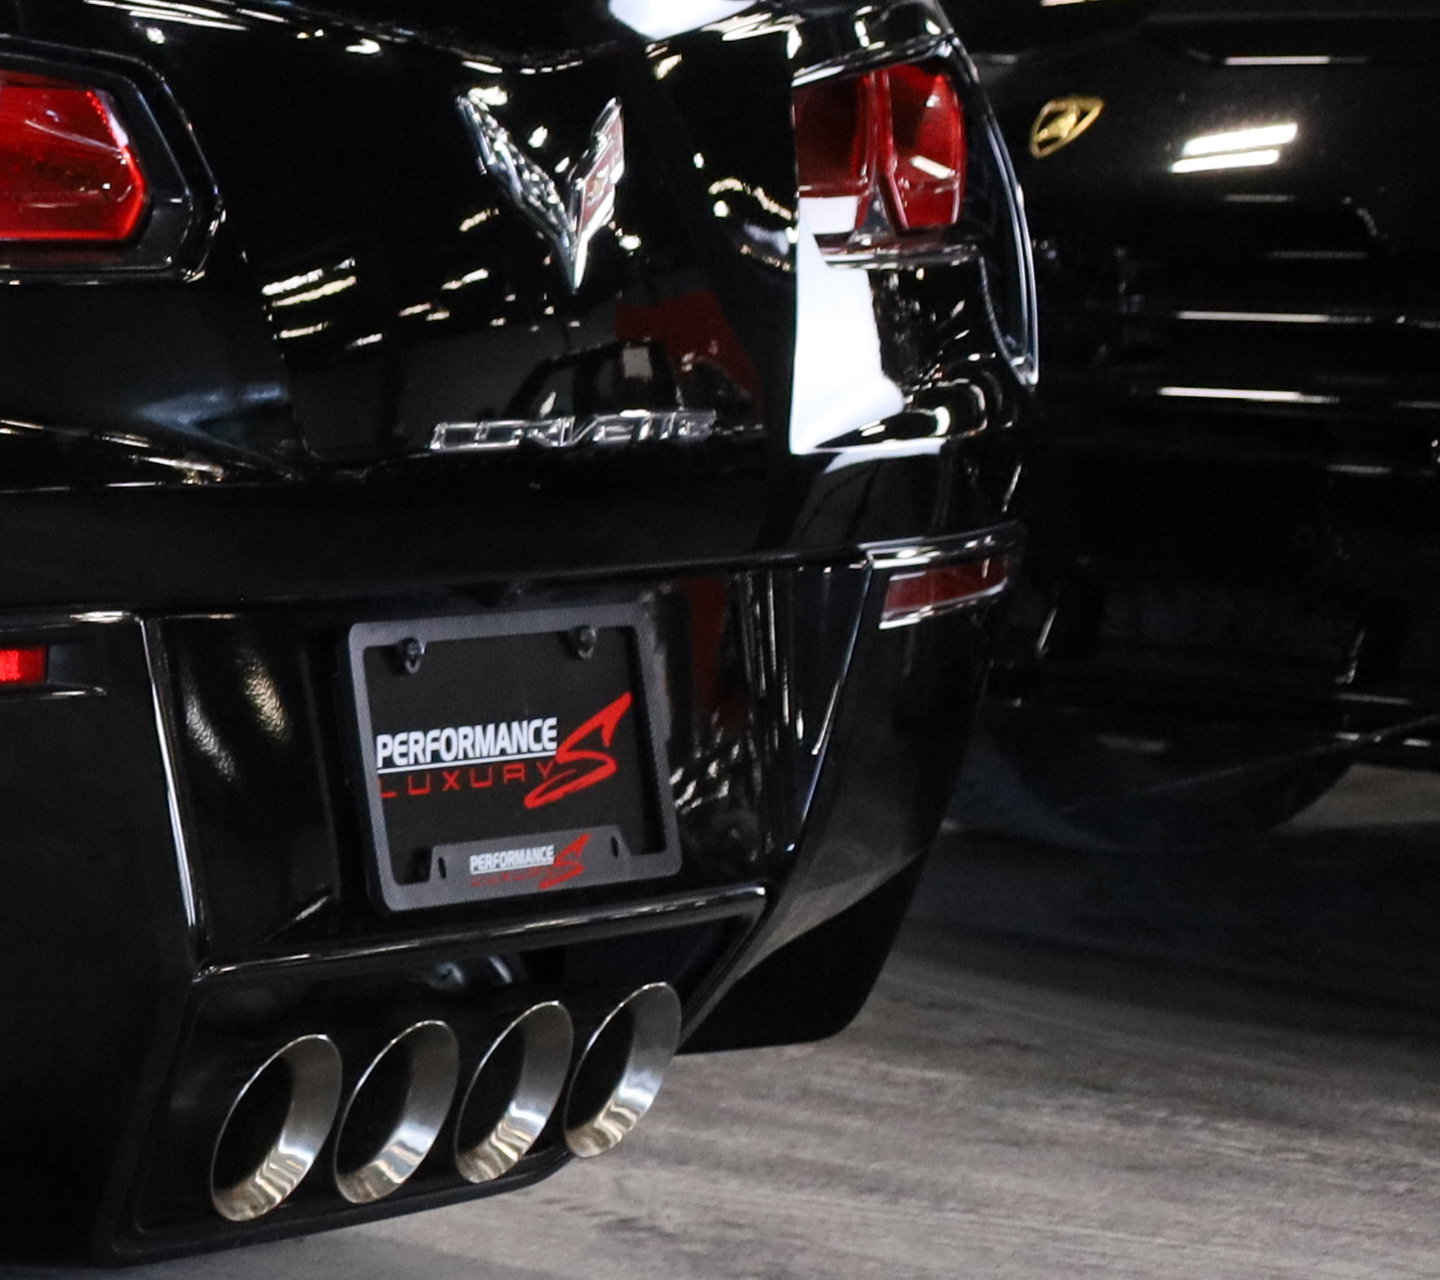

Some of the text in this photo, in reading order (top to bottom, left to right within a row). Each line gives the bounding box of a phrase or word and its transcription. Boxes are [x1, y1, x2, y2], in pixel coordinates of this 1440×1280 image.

[428, 408, 718, 450] CORVETTE
[376, 717, 558, 767] PERFORMANCE
[378, 758, 556, 799] LUXURY
[470, 846, 554, 872] PERFORMANCE
